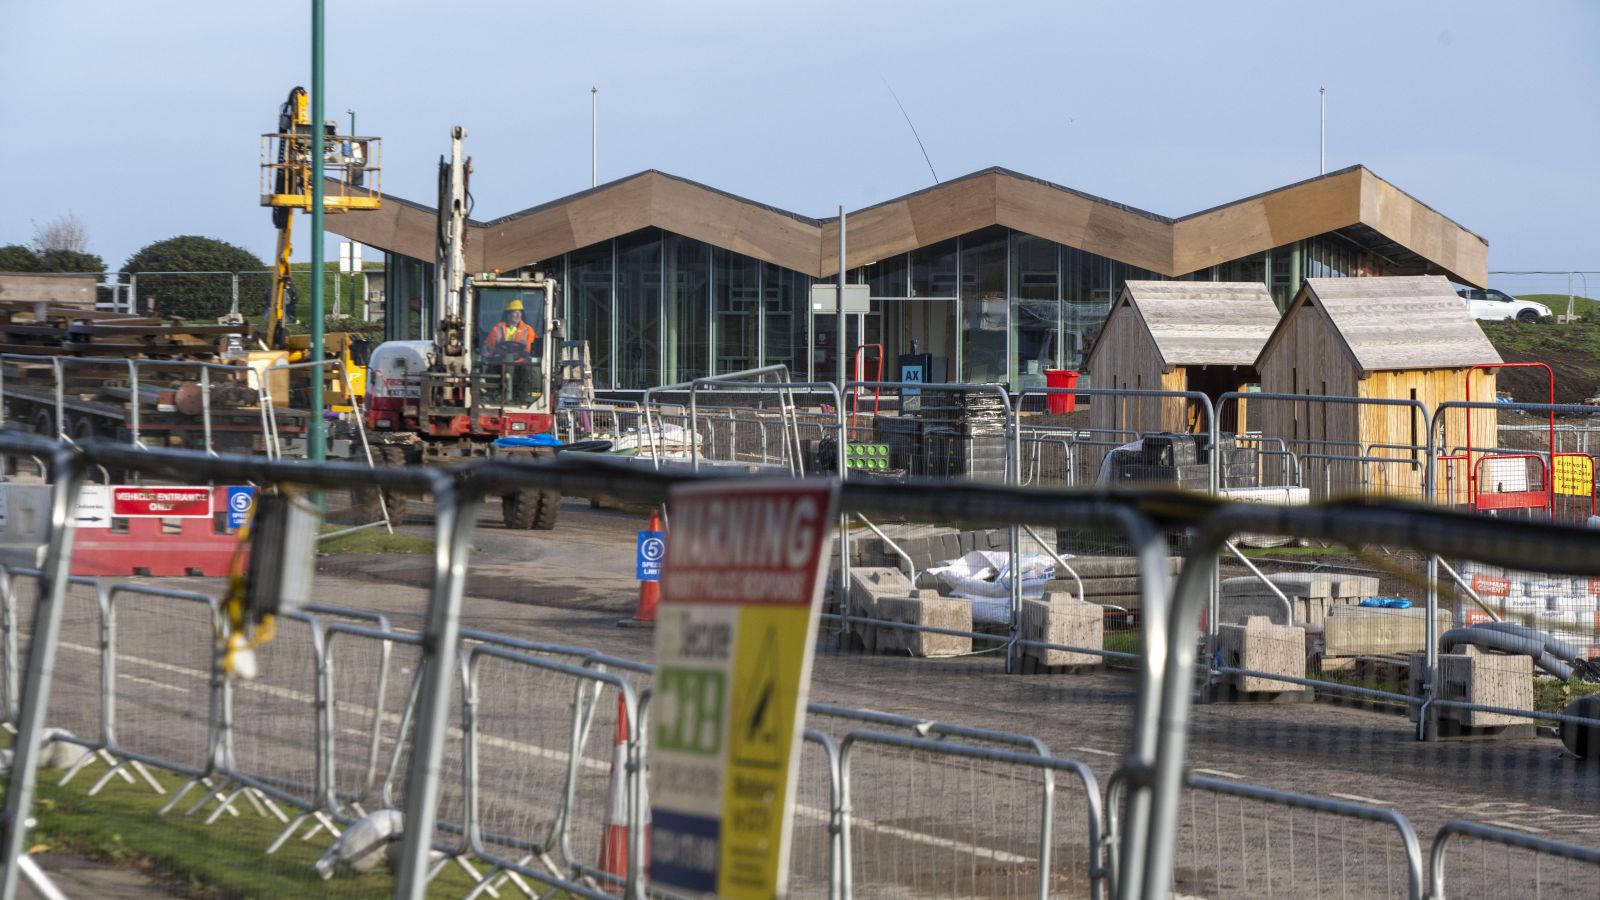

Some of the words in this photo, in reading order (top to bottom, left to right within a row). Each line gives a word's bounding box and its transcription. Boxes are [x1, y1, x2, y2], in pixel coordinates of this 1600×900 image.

[905, 370, 919, 381] AX
[115, 492, 157, 501] VEHICLE
[157, 492, 207, 502] ENTRANCE
[236, 495, 247, 509] 5
[149, 502, 174, 511] ONLY
[670, 496, 818, 568] WARNING
[648, 541, 658, 557] 5
